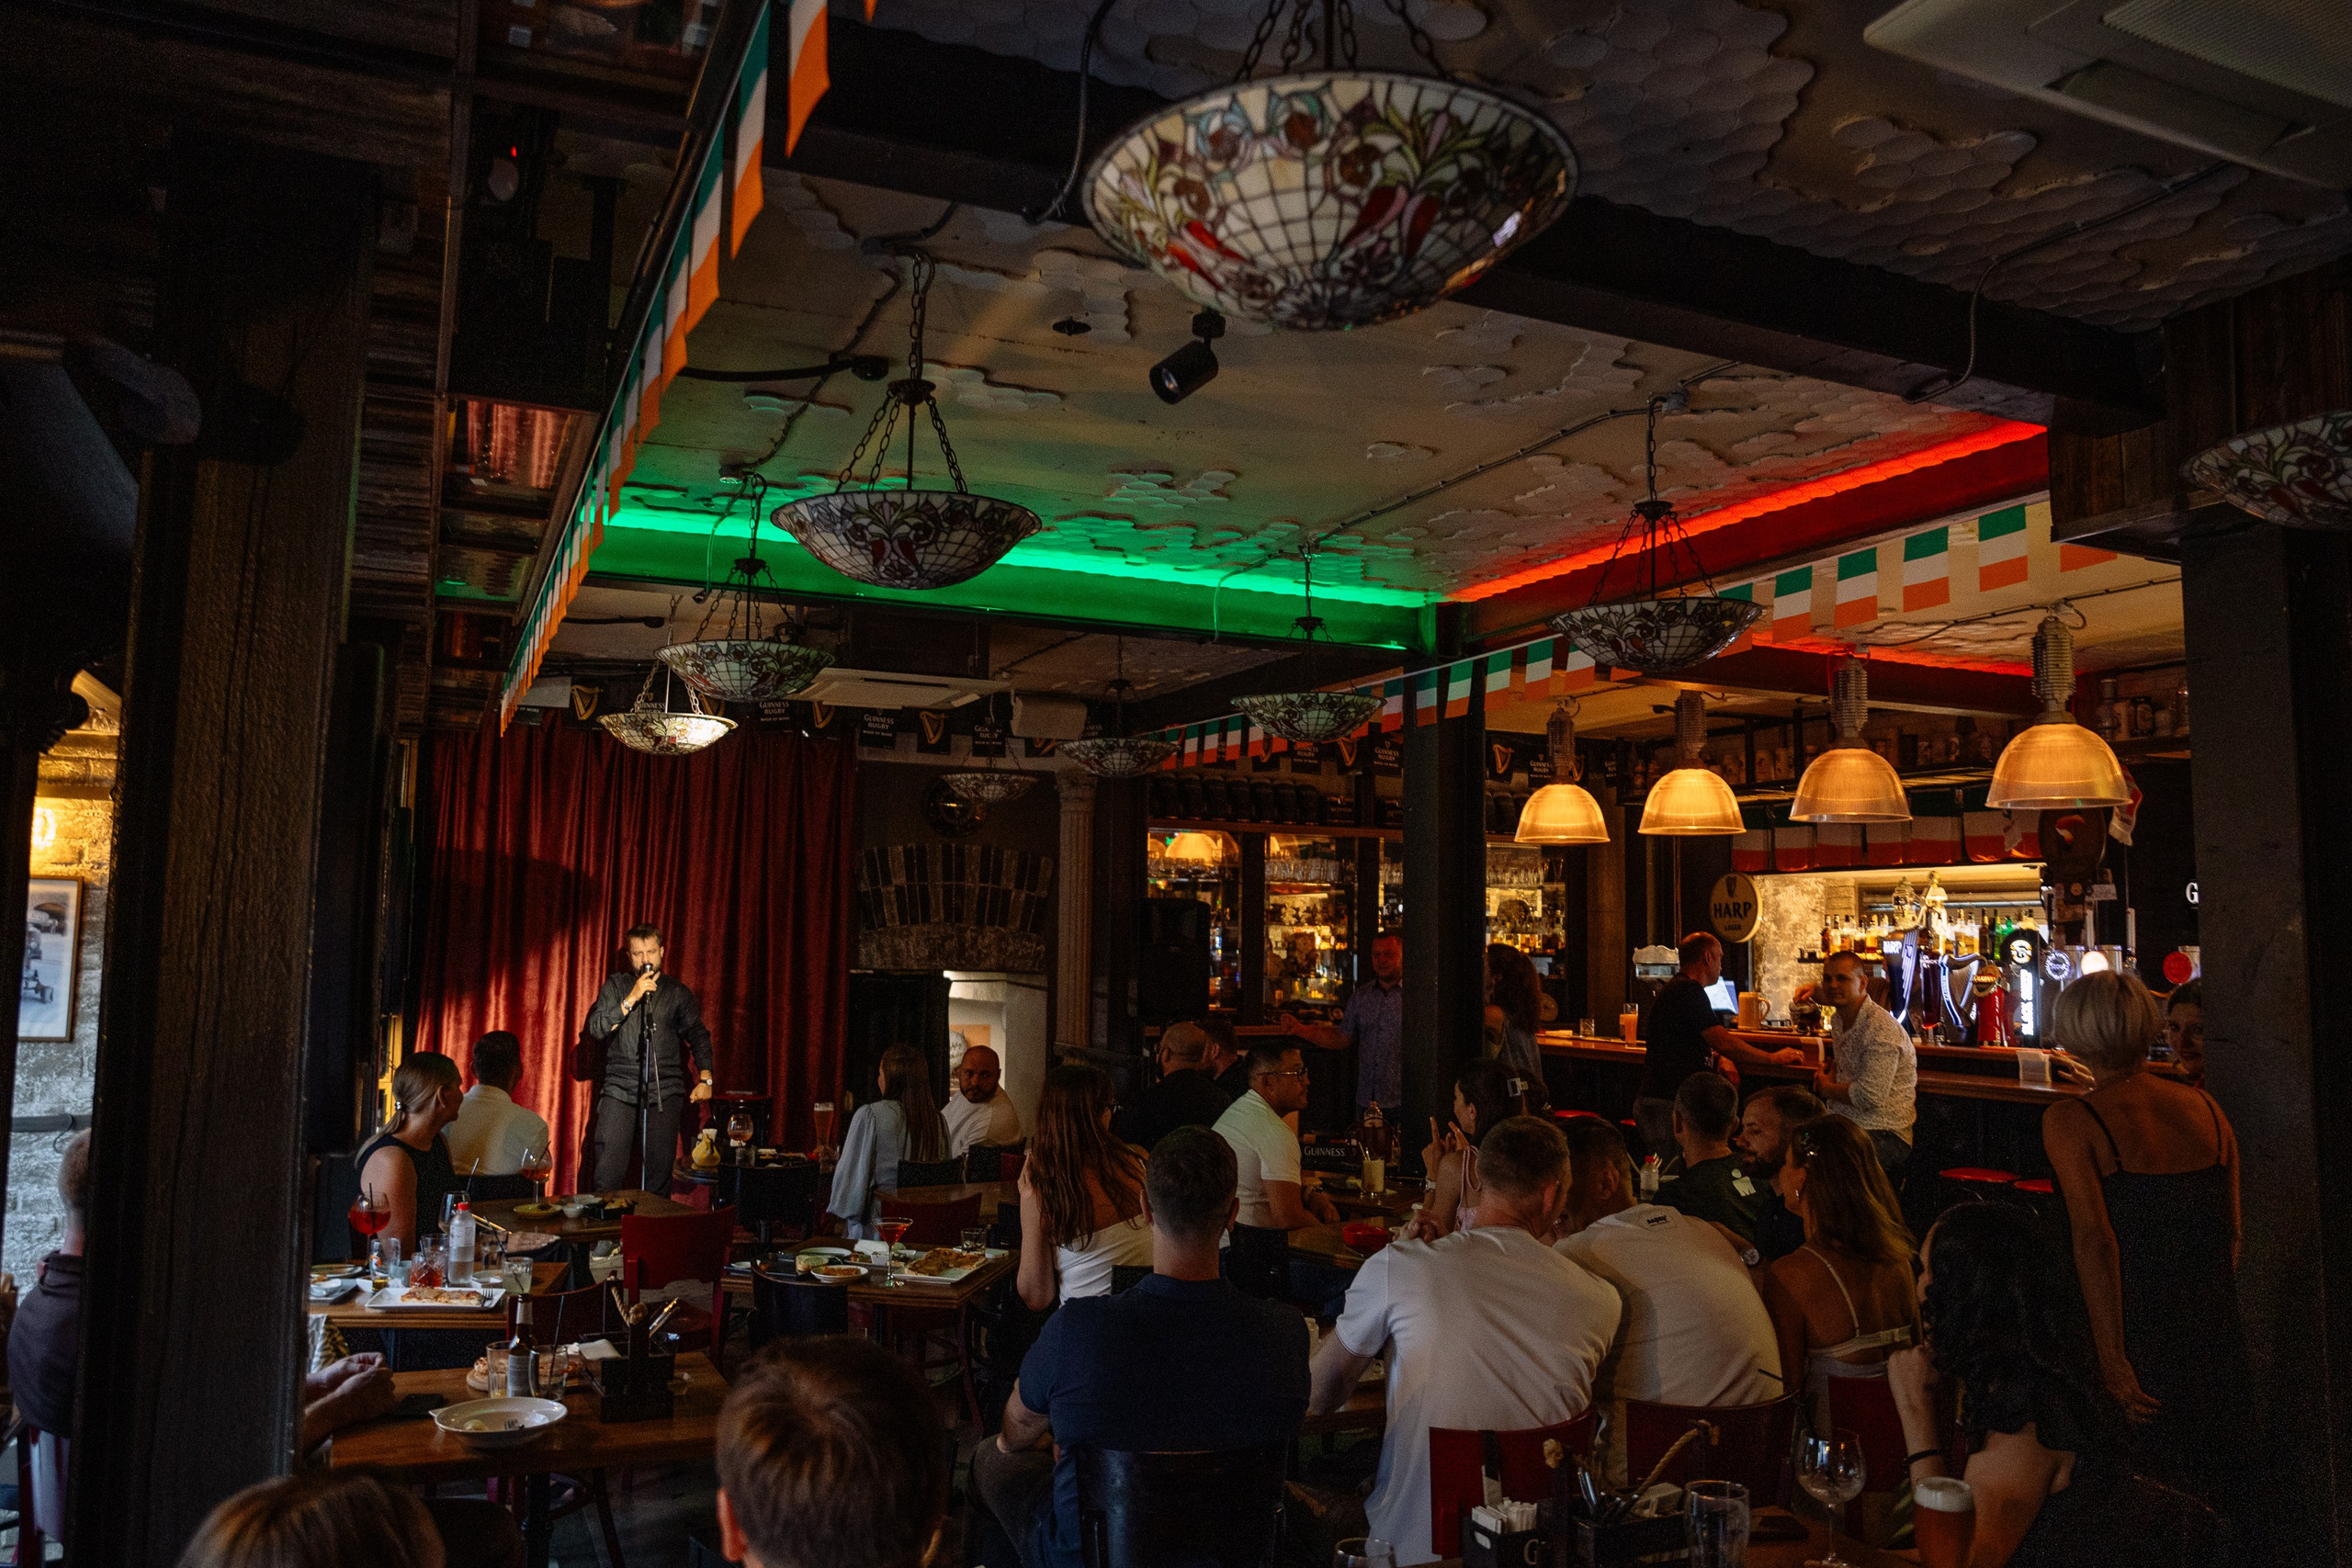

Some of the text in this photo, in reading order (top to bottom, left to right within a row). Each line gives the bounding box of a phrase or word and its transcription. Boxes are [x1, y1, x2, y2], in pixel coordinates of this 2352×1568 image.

[759, 701, 790, 709] GUINNESS
[864, 714, 895, 725] GUINNESS
[867, 722, 890, 730] RUGBY
[1374, 747, 1400, 757] GUINNESS
[1713, 902, 1752, 919] HARP
[1303, 1145, 1348, 1157] GUINNESS
